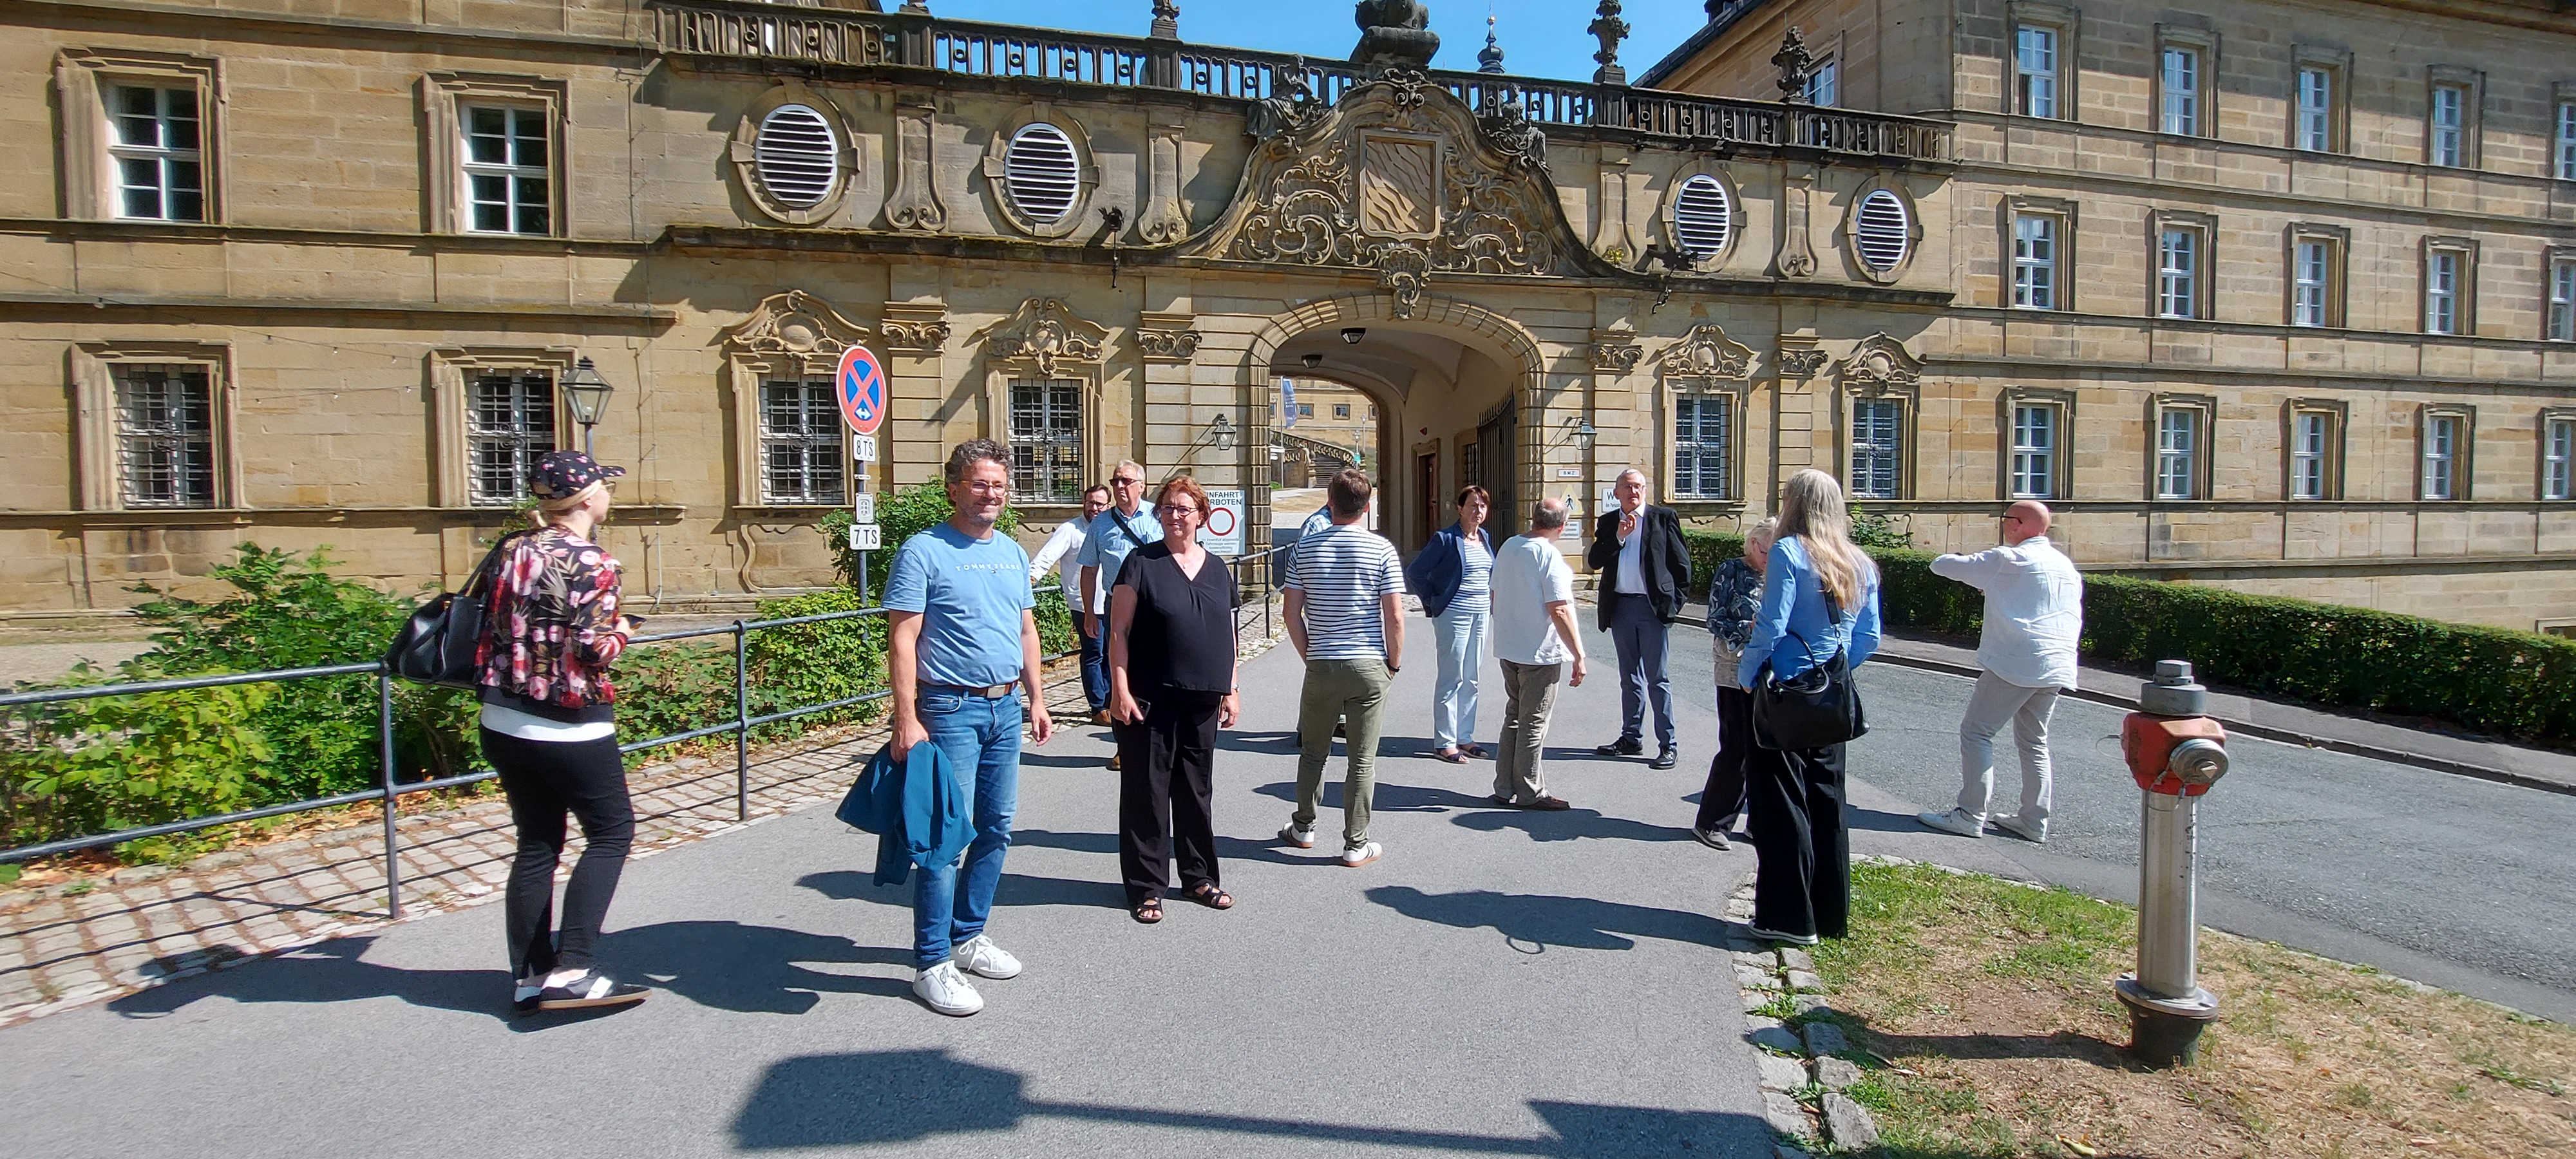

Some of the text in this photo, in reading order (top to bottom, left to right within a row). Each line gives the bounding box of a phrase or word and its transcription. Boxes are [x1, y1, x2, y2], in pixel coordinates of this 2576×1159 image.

[857, 440, 873, 456] 8 TS
[854, 529, 877, 544] 7 TS
